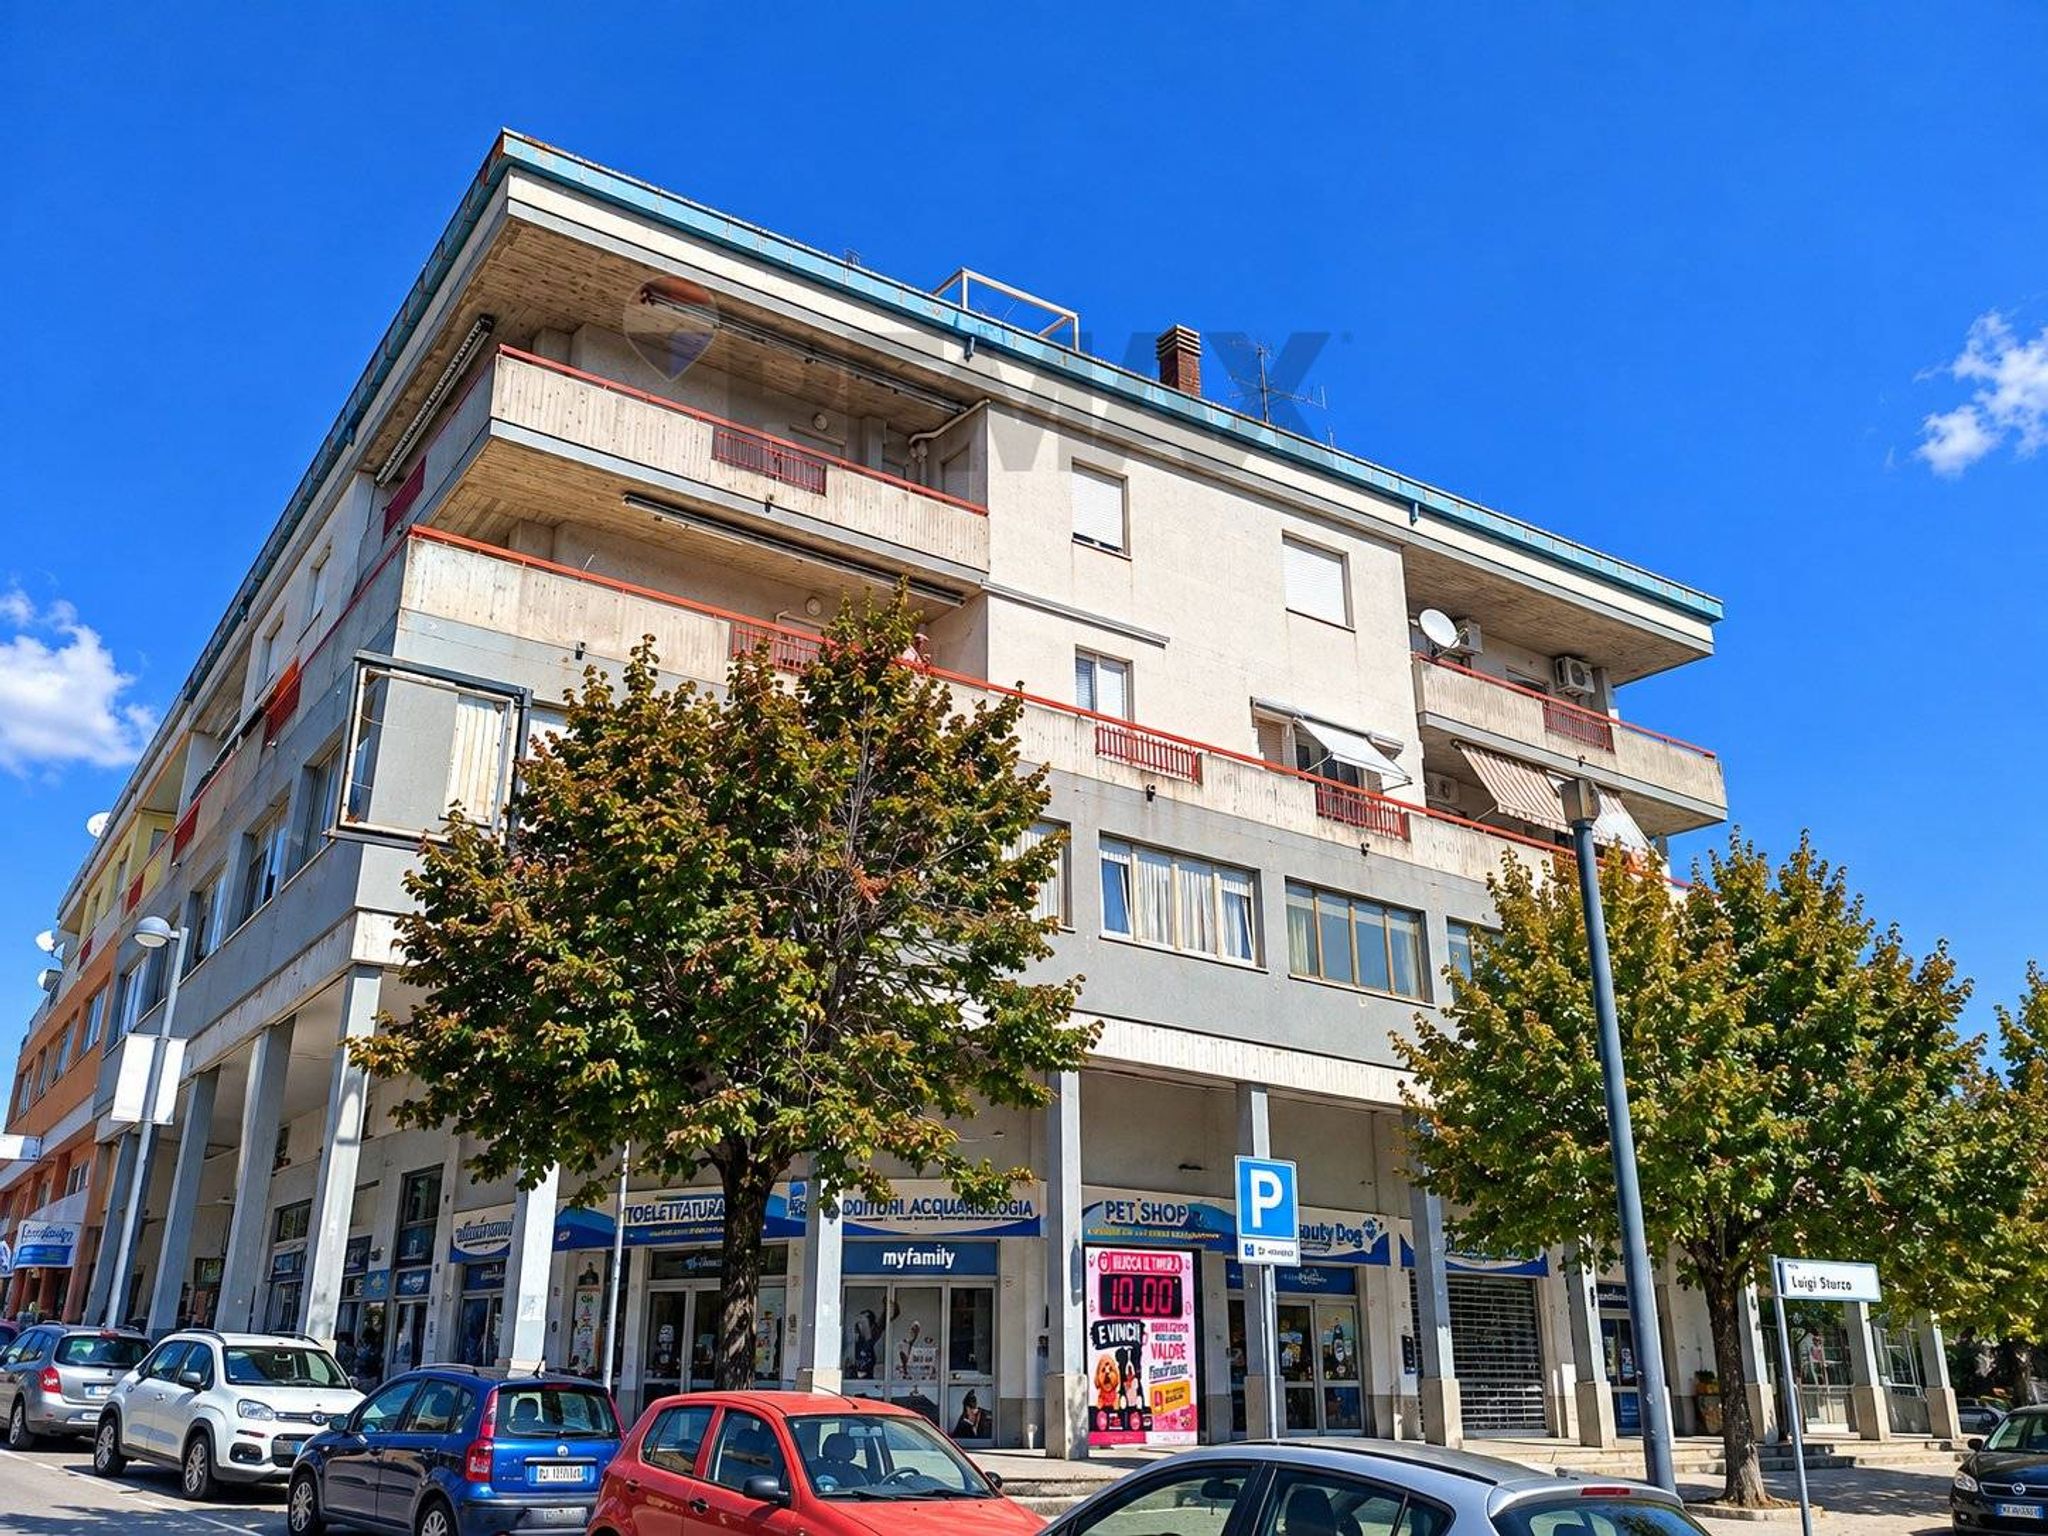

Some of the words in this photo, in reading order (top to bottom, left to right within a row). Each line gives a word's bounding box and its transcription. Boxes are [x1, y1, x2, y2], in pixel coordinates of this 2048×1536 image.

[1250, 1169, 1283, 1228] P
[1105, 1200, 1135, 1222] PET
[1141, 1202, 1188, 1225] SHOP
[1336, 1222, 1362, 1249] Dog
[882, 1244, 955, 1268] myfamily
[1791, 1276, 1817, 1292] Luigi
